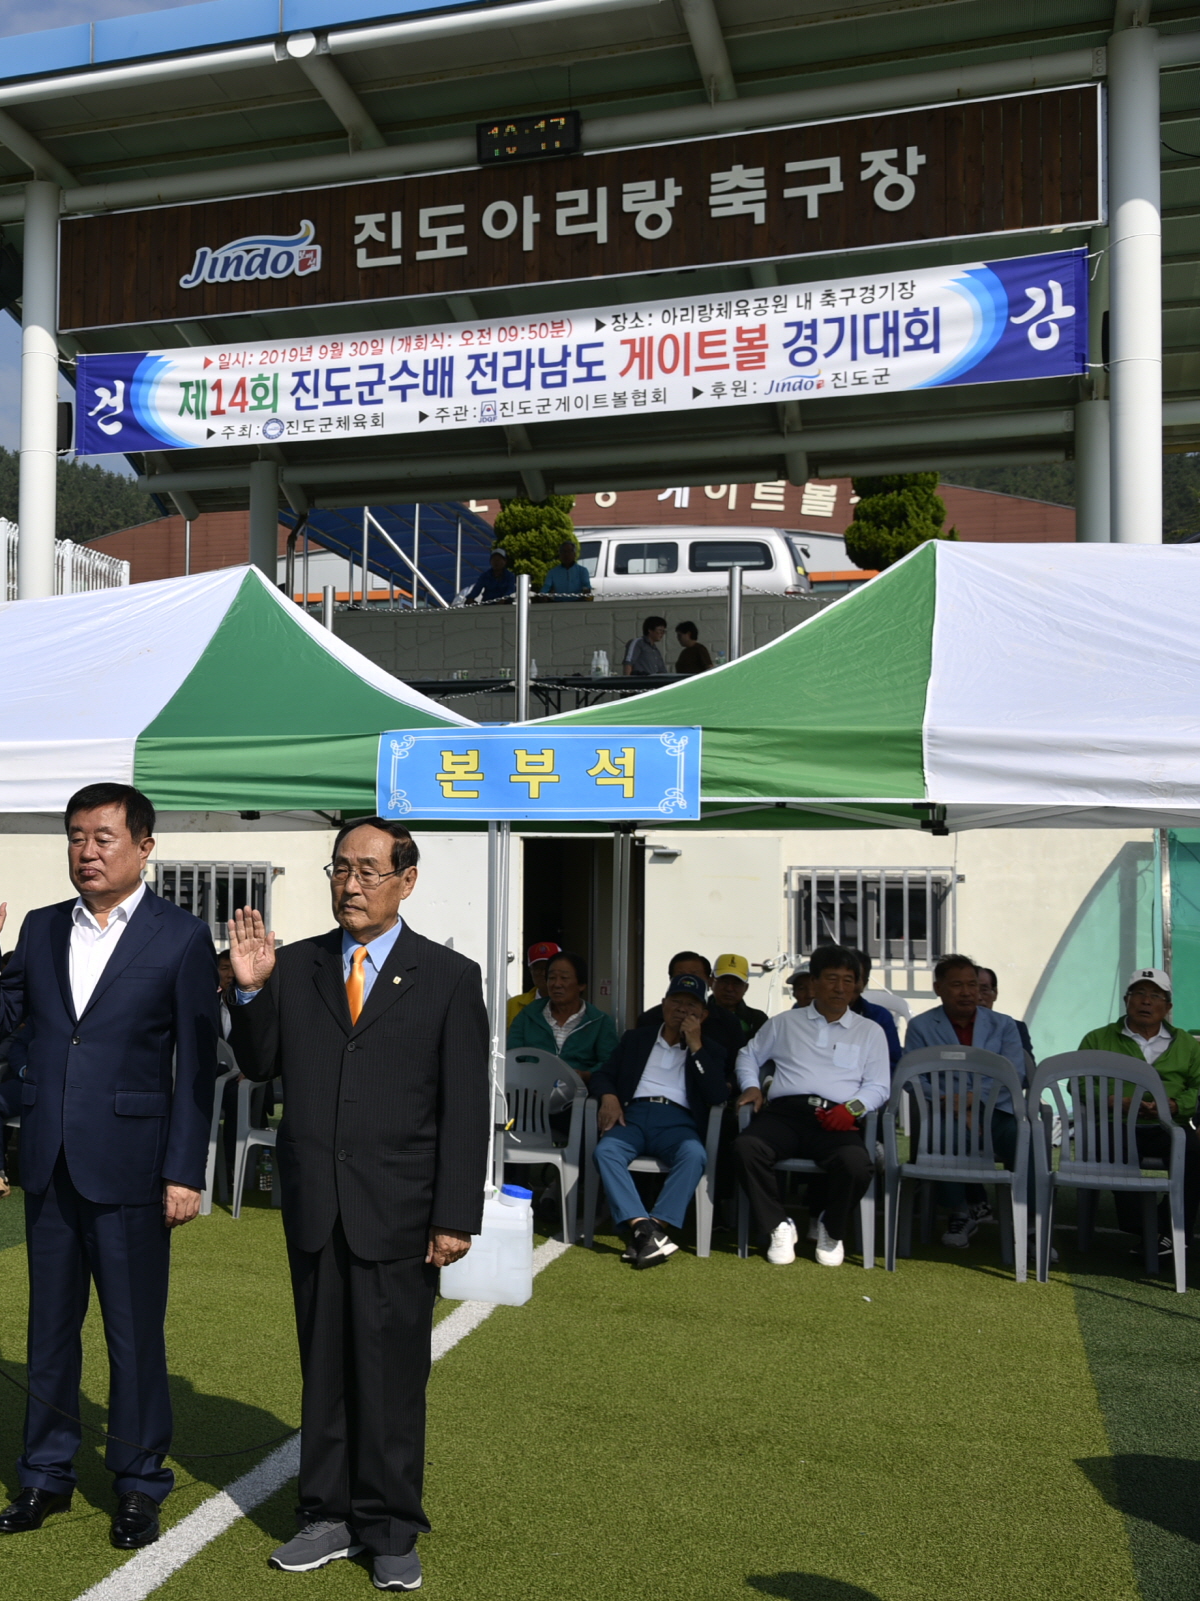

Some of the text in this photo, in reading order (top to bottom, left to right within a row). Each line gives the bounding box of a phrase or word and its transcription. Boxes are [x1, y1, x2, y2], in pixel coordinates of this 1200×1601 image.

[353, 145, 927, 269] 진도아리랑 축구장
[183, 246, 295, 285] Jindo
[611, 279, 917, 333] 장소: 아리랑체육공원 내 축구경기장
[1009, 279, 1076, 351] 강
[177, 305, 941, 421] 제14회 진도군수배 전라남도 게이트볼 경기대회
[218, 317, 574, 370] 일시: 2019년 9월 30일 (개회식: 오전 09:50분)
[87, 378, 126, 436] 건
[498, 386, 668, 418] 진도군게이트볼협회
[763, 376, 815, 397] Jindo
[829, 366, 892, 391] 진도군
[284, 411, 386, 436] 진도군체육회
[656, 480, 861, 518] 게이트볼
